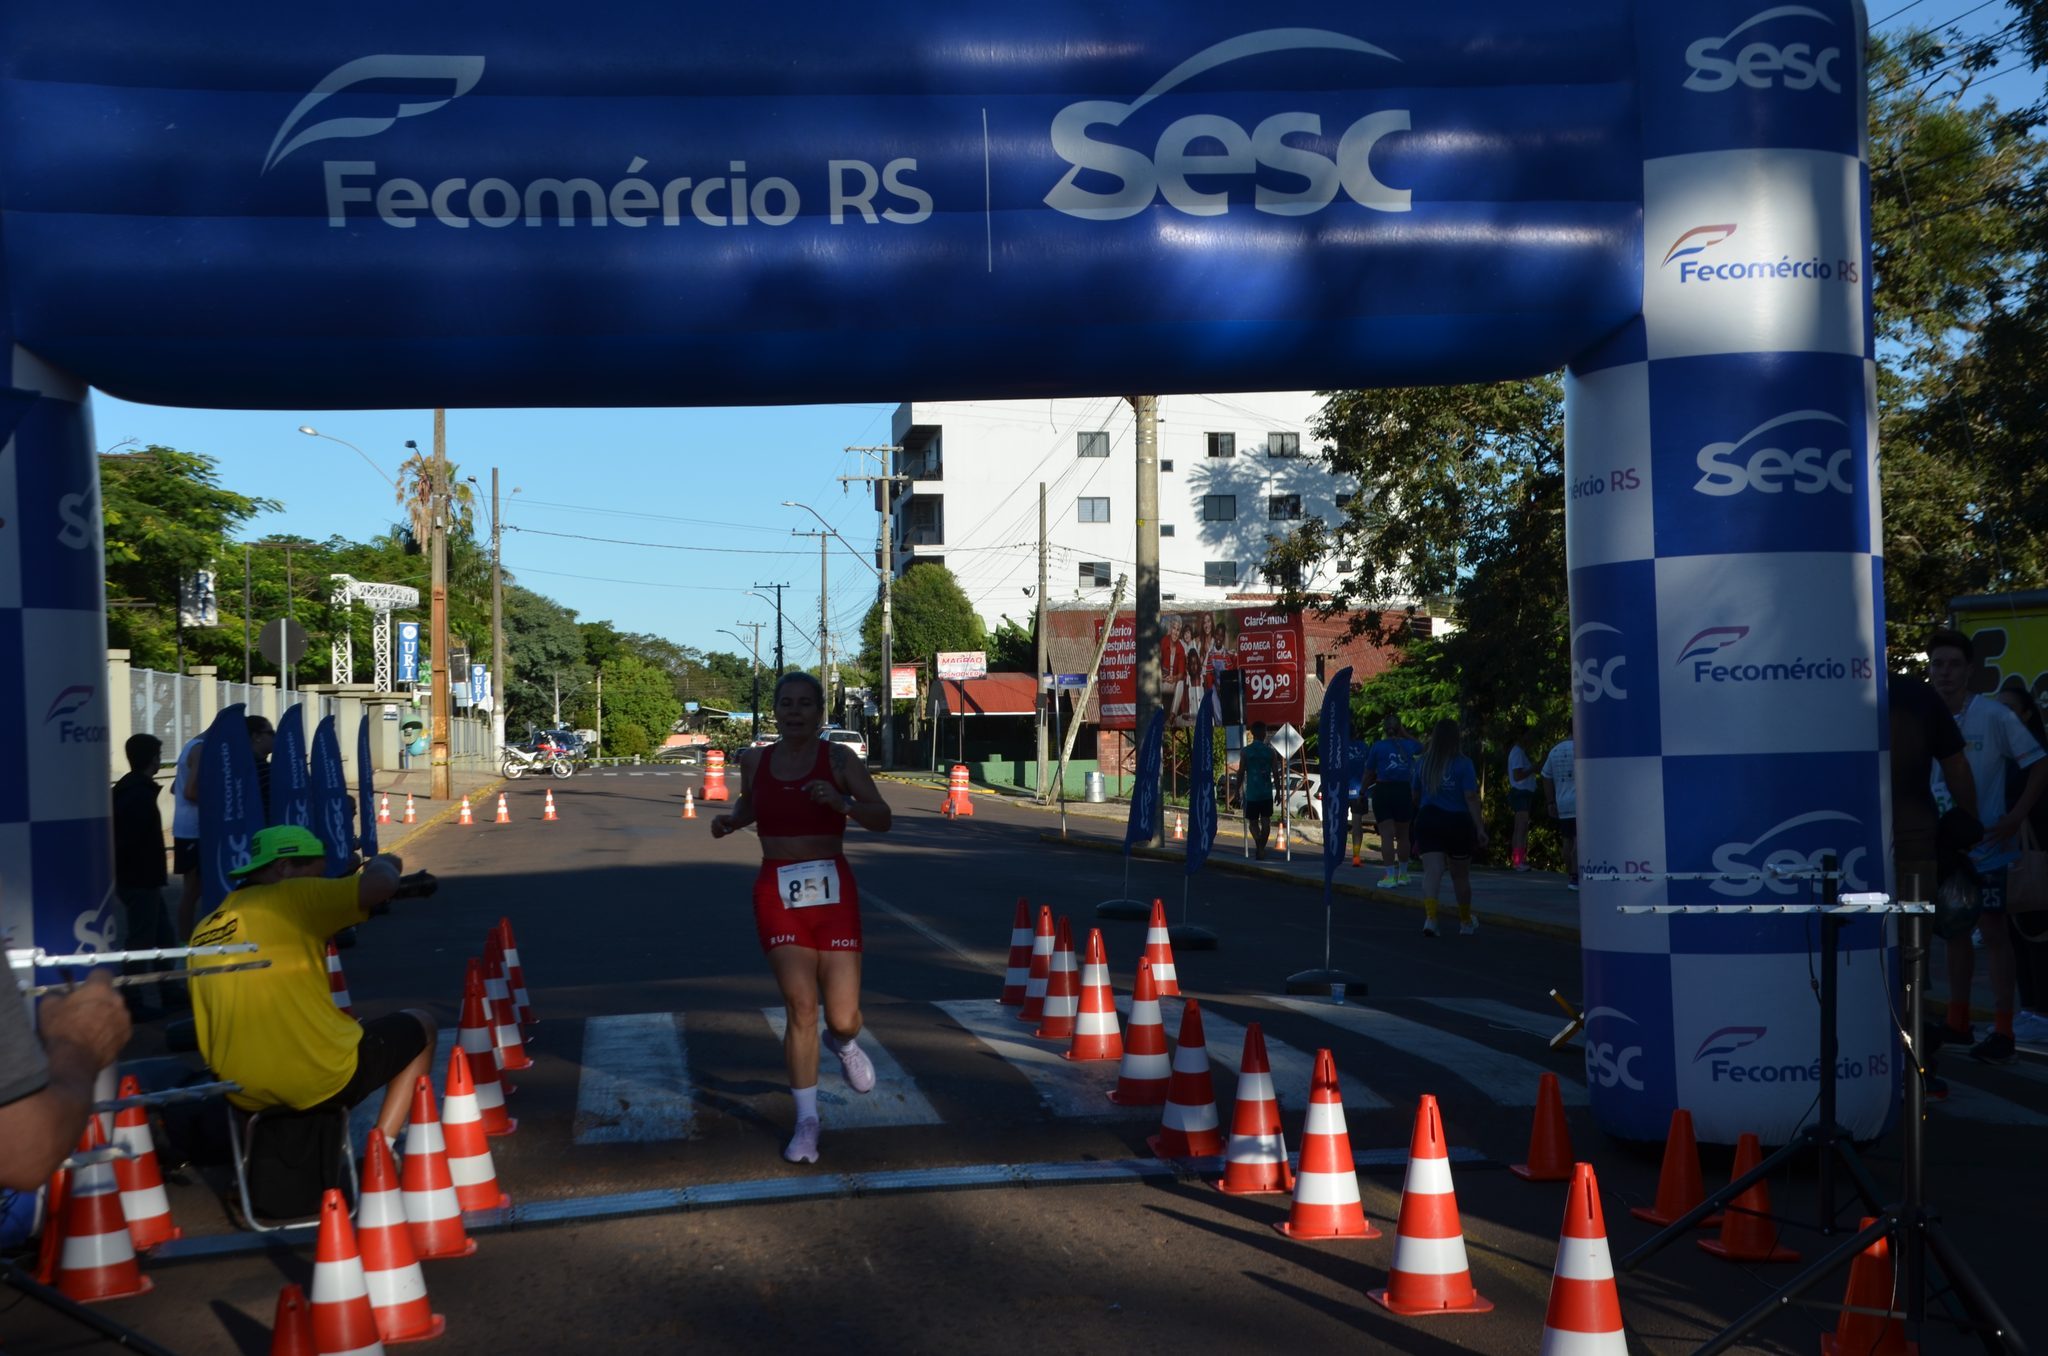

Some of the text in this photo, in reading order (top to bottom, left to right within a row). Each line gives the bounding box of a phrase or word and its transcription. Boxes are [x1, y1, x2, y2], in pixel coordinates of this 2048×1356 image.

[1682, 37, 1841, 94] Sesc
[1043, 100, 1412, 220] Sesc
[322, 156, 933, 228] Fecomércio RS
[1681, 256, 1858, 284] Fecomércio RS
[1611, 467, 1641, 492] RS
[1693, 442, 1854, 497] Sesc
[1253, 641, 1271, 650] MEGA
[1276, 650, 1293, 660] GIGA
[403, 641, 417, 679] URI
[1694, 657, 1872, 682] Fecomércio RS
[475, 677, 483, 702] URI
[789, 876, 830, 902] 851
[770, 934, 796, 945] RUN
[1712, 1055, 1889, 1083] Fecomécio RS
